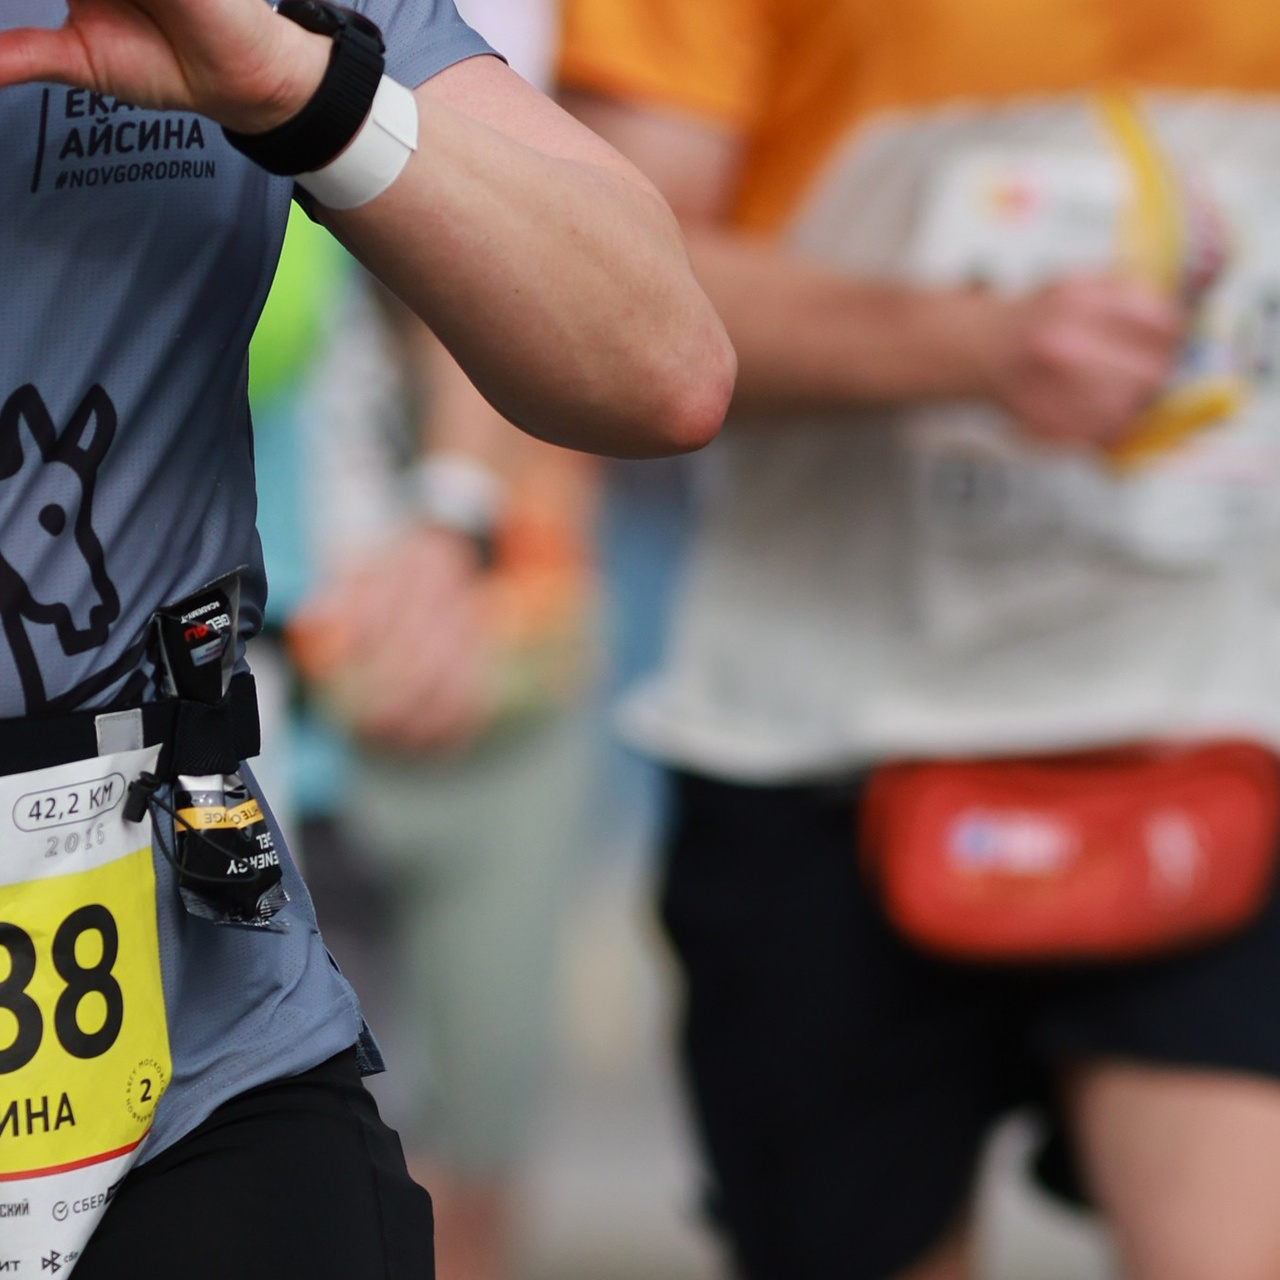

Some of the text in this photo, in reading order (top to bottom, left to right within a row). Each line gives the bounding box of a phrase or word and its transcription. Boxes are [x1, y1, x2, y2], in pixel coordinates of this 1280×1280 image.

[58, 116, 205, 161] АЙСИНА
[54, 159, 216, 191] #NOVGORODRUN
[27, 780, 115, 822] 42,2 КМ
[140, 1078, 152, 1103] 2
[72, 1193, 105, 1214] СБЕР
